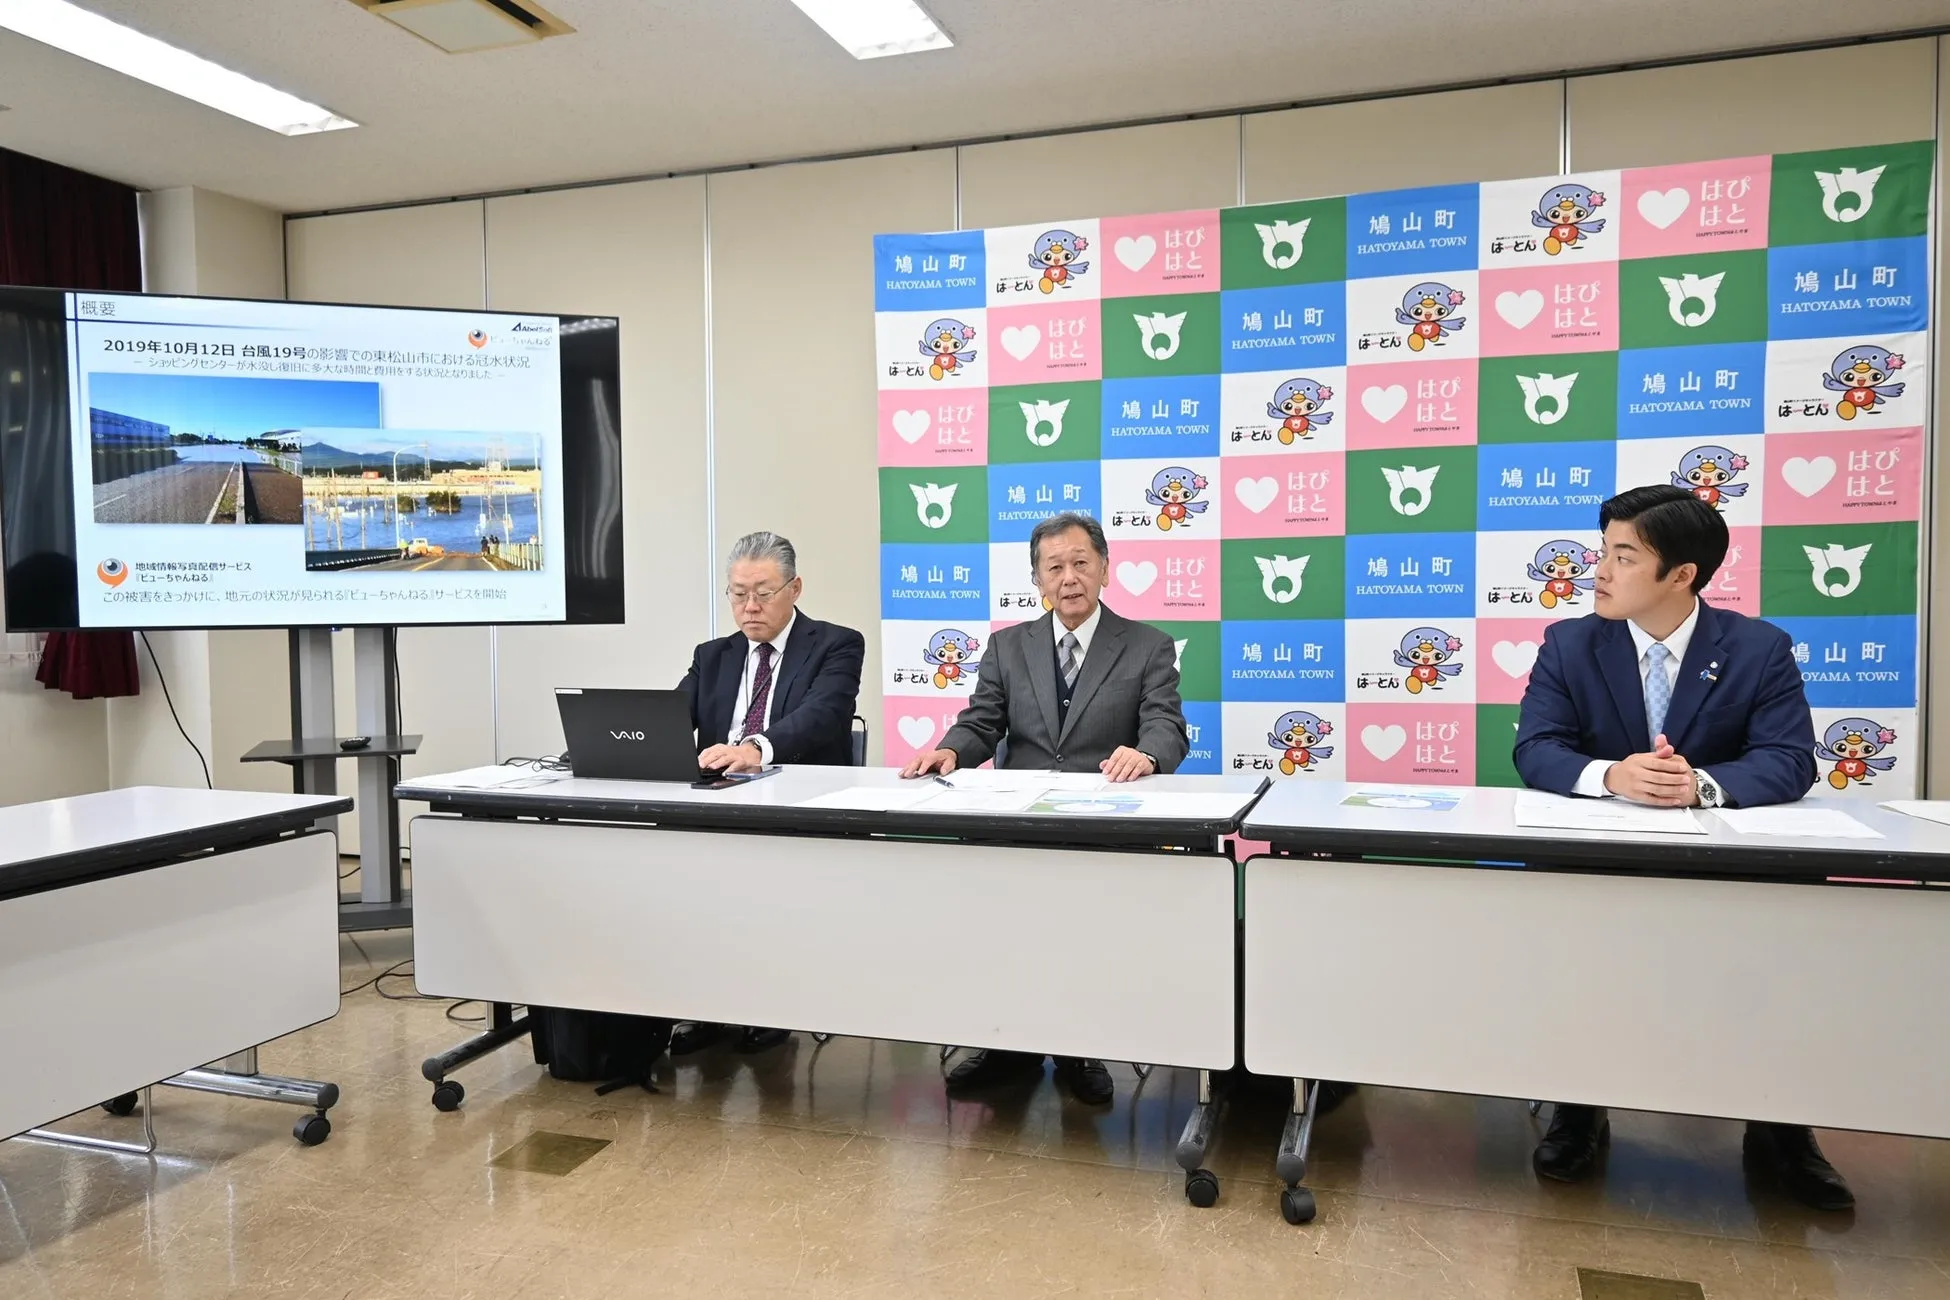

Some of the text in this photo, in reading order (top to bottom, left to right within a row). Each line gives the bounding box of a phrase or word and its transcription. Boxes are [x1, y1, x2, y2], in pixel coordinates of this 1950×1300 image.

[1700, 174, 1752, 201] はぴ
[1370, 210, 1456, 235] 鳩山町
[1699, 203, 1747, 228] はと
[1164, 226, 1206, 249] はぴ
[1357, 235, 1468, 255] HATOYAMA TOWN
[896, 255, 966, 273] 鳩山町
[1165, 251, 1202, 271] はと
[886, 276, 976, 290] HATOYAMA TOWN
[1795, 267, 1897, 292] 鳩山町
[1553, 281, 1602, 302] はぴ
[80, 301, 116, 316] 概要
[1781, 295, 1912, 314] HATOYAMA TOWN
[1048, 317, 1086, 337] はぴ
[1243, 308, 1323, 331] 鳩山町
[1553, 307, 1600, 329] はと
[1049, 340, 1084, 361] はと
[1231, 333, 1336, 350] HATOYAMA TOWN
[104, 339, 531, 369] 2019年10月12日 台風19号の影響での東松山市における冠水状況
[1416, 376, 1462, 400] はぴ
[1643, 370, 1738, 394] 鳩山町
[938, 404, 974, 423] はぴ
[1122, 399, 1199, 419] 鳩山町
[1416, 402, 1457, 423] はと
[1629, 398, 1752, 414] HATOYAMA TOWN
[938, 427, 972, 445] はと
[1111, 424, 1210, 437] HATOYAMA TOWN
[1847, 445, 1902, 471] はぴ
[1287, 471, 1329, 490] はぴ
[1501, 466, 1592, 488] 鳩山町
[1845, 474, 1897, 498] はと
[1008, 484, 1081, 504] 鳩山町
[1287, 494, 1327, 514] はと
[1488, 494, 1605, 507] HATOYAMA TOWN
[997, 509, 1057, 522] HATOYAMA
[1166, 557, 1205, 576] はぴ
[1721, 545, 1742, 568] ぴ
[135, 562, 252, 572] 地域情報写真配信サービス
[901, 565, 970, 583] 鳩山町
[1368, 557, 1452, 577] 鳩山町
[892, 589, 981, 599] HATOYAMA TOWN
[1166, 580, 1203, 598] はと
[1356, 583, 1464, 595] HATOYAMA TOWN
[1243, 643, 1323, 662] 鳩山町
[1231, 669, 1335, 679] HATOYAMA TOWN
[1800, 671, 1899, 682] OYAMA TOWN
[610, 730, 645, 741] VAIO
[1416, 720, 1460, 741] はぴ
[1186, 750, 1212, 759] OWN
[1416, 745, 1456, 764] はと
